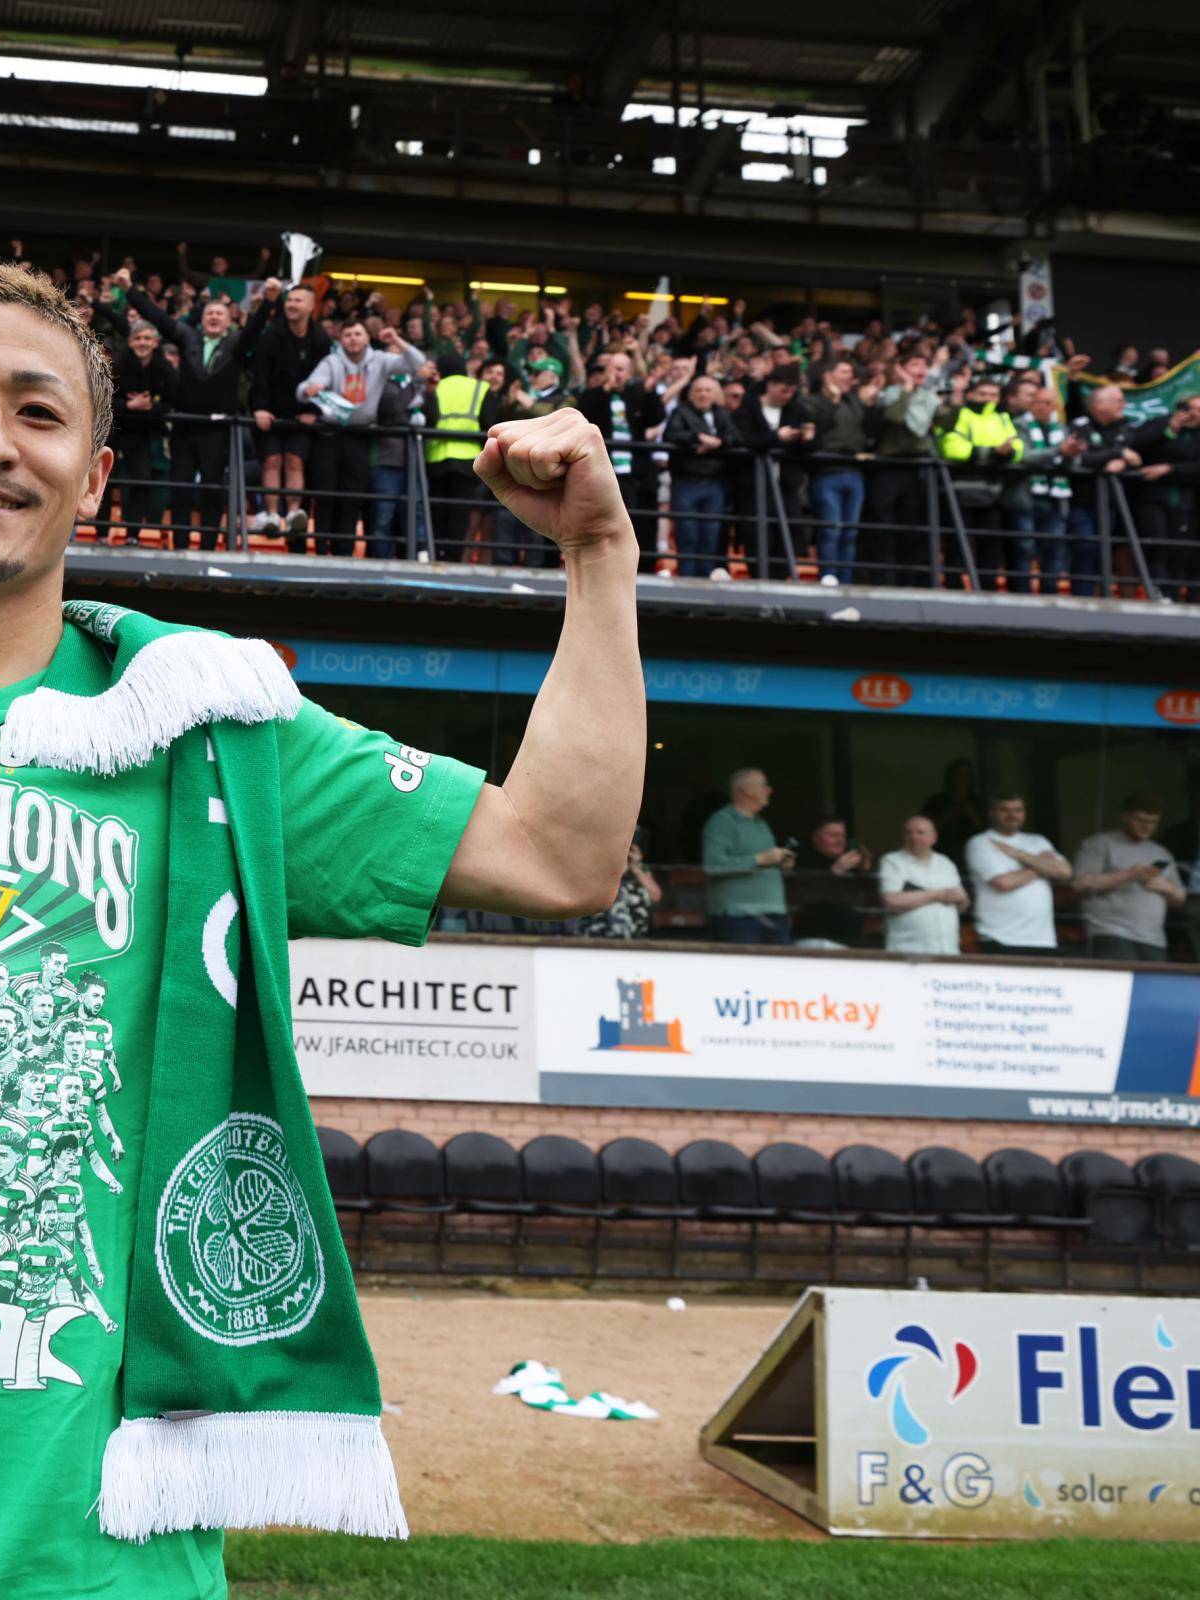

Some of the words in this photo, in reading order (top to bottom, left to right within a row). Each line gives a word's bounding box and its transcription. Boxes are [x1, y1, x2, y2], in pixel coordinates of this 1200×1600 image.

[311, 649, 412, 680] Lounge
[644, 670, 723, 698] unge
[925, 681, 1023, 713] Lounge
[298, 977, 518, 1013] ARCHITECT
[932, 979, 990, 994] Quantity
[995, 981, 1063, 998] Surveying
[715, 990, 880, 1030] wjrmckay
[933, 999, 981, 1012] Project
[986, 1001, 1073, 1015] Management
[1010, 1021, 1049, 1036] Agent
[936, 1039, 1026, 1053] Development
[1031, 1042, 1105, 1058] Monitoring
[937, 1058, 997, 1073] Principal
[1001, 1060, 1061, 1075] Designer
[168, 1191, 196, 1234] THE
[188, 1139, 226, 1189] CELTI
[226, 1304, 269, 1330] 1888
[1057, 1473, 1128, 1504] solar
